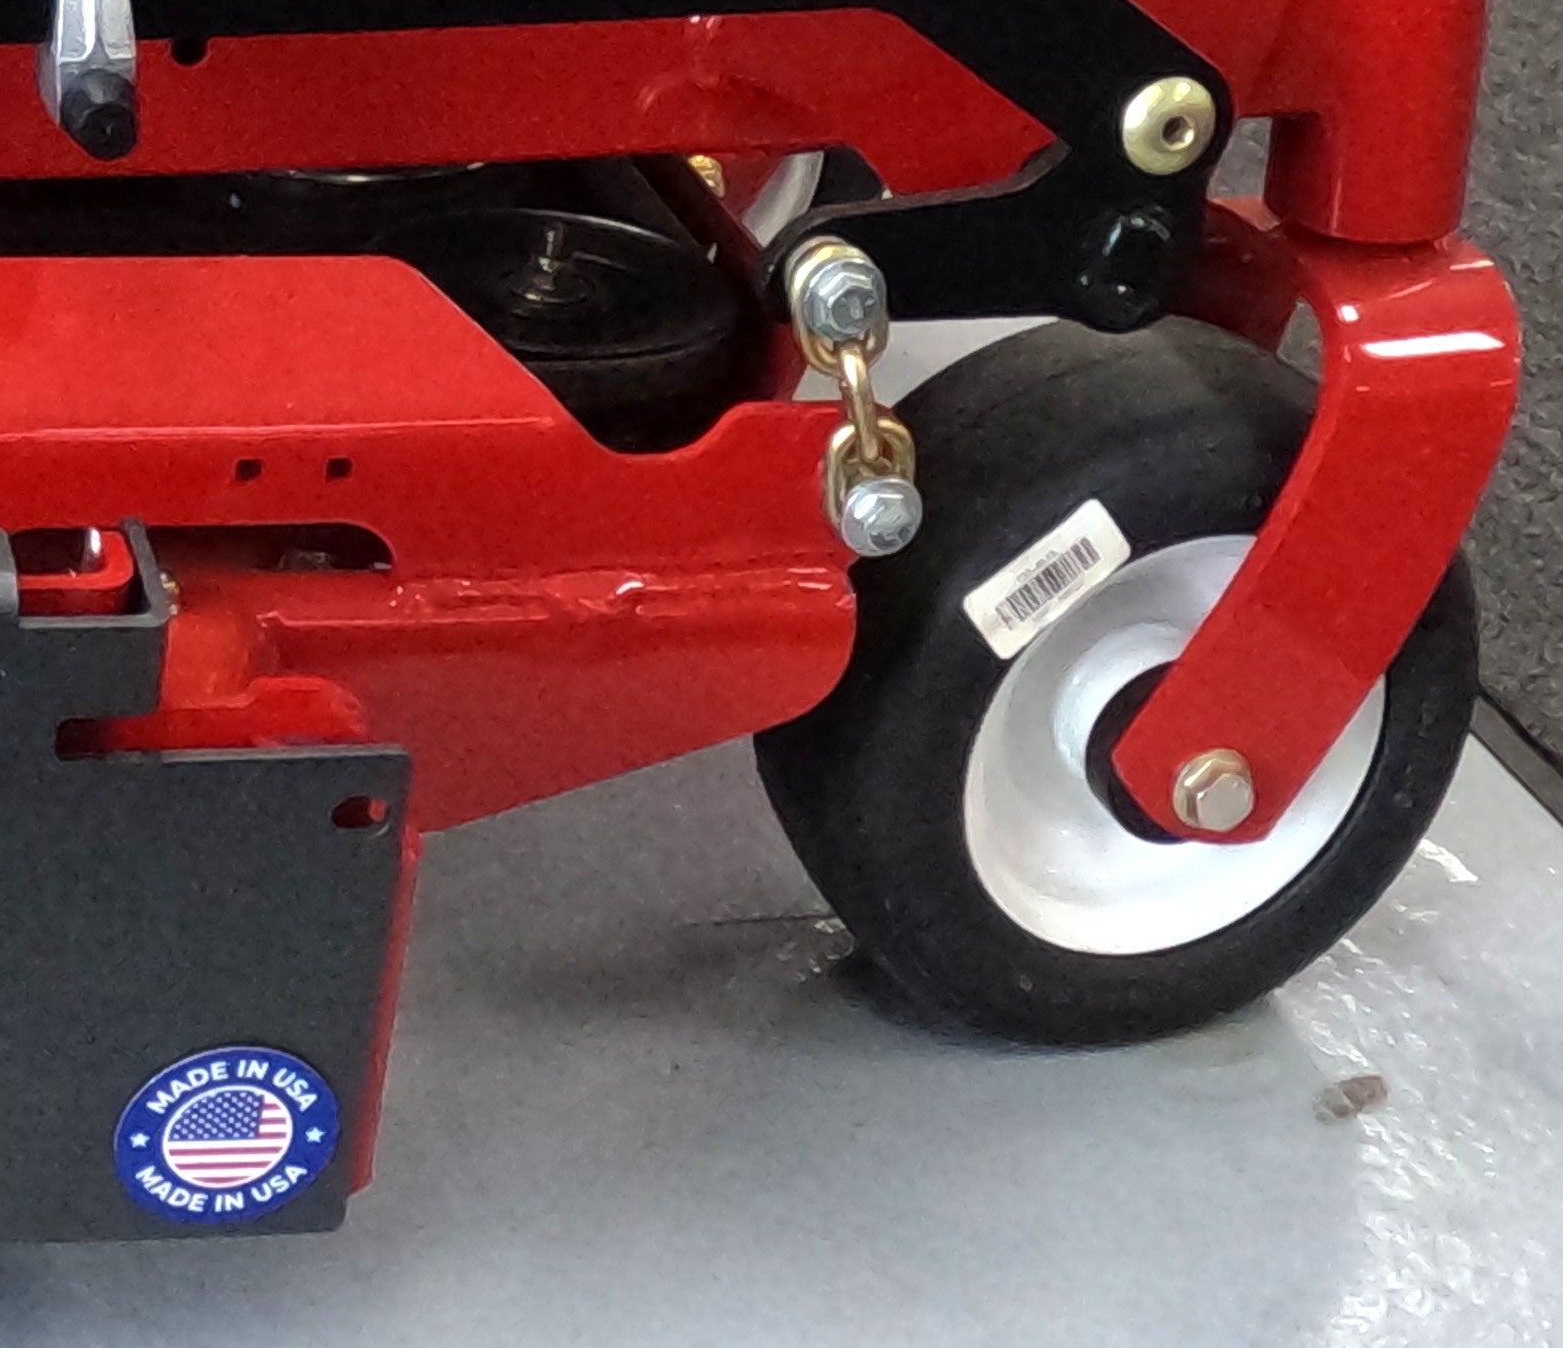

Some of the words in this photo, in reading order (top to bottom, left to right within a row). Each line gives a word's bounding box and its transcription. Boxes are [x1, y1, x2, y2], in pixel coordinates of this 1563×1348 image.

[145, 1060, 230, 1115] MADE
[236, 1059, 270, 1079] IN
[272, 1067, 320, 1113] USA
[134, 1163, 210, 1214] MADE
[214, 1190, 245, 1214] IN
[250, 1163, 309, 1204] USA
